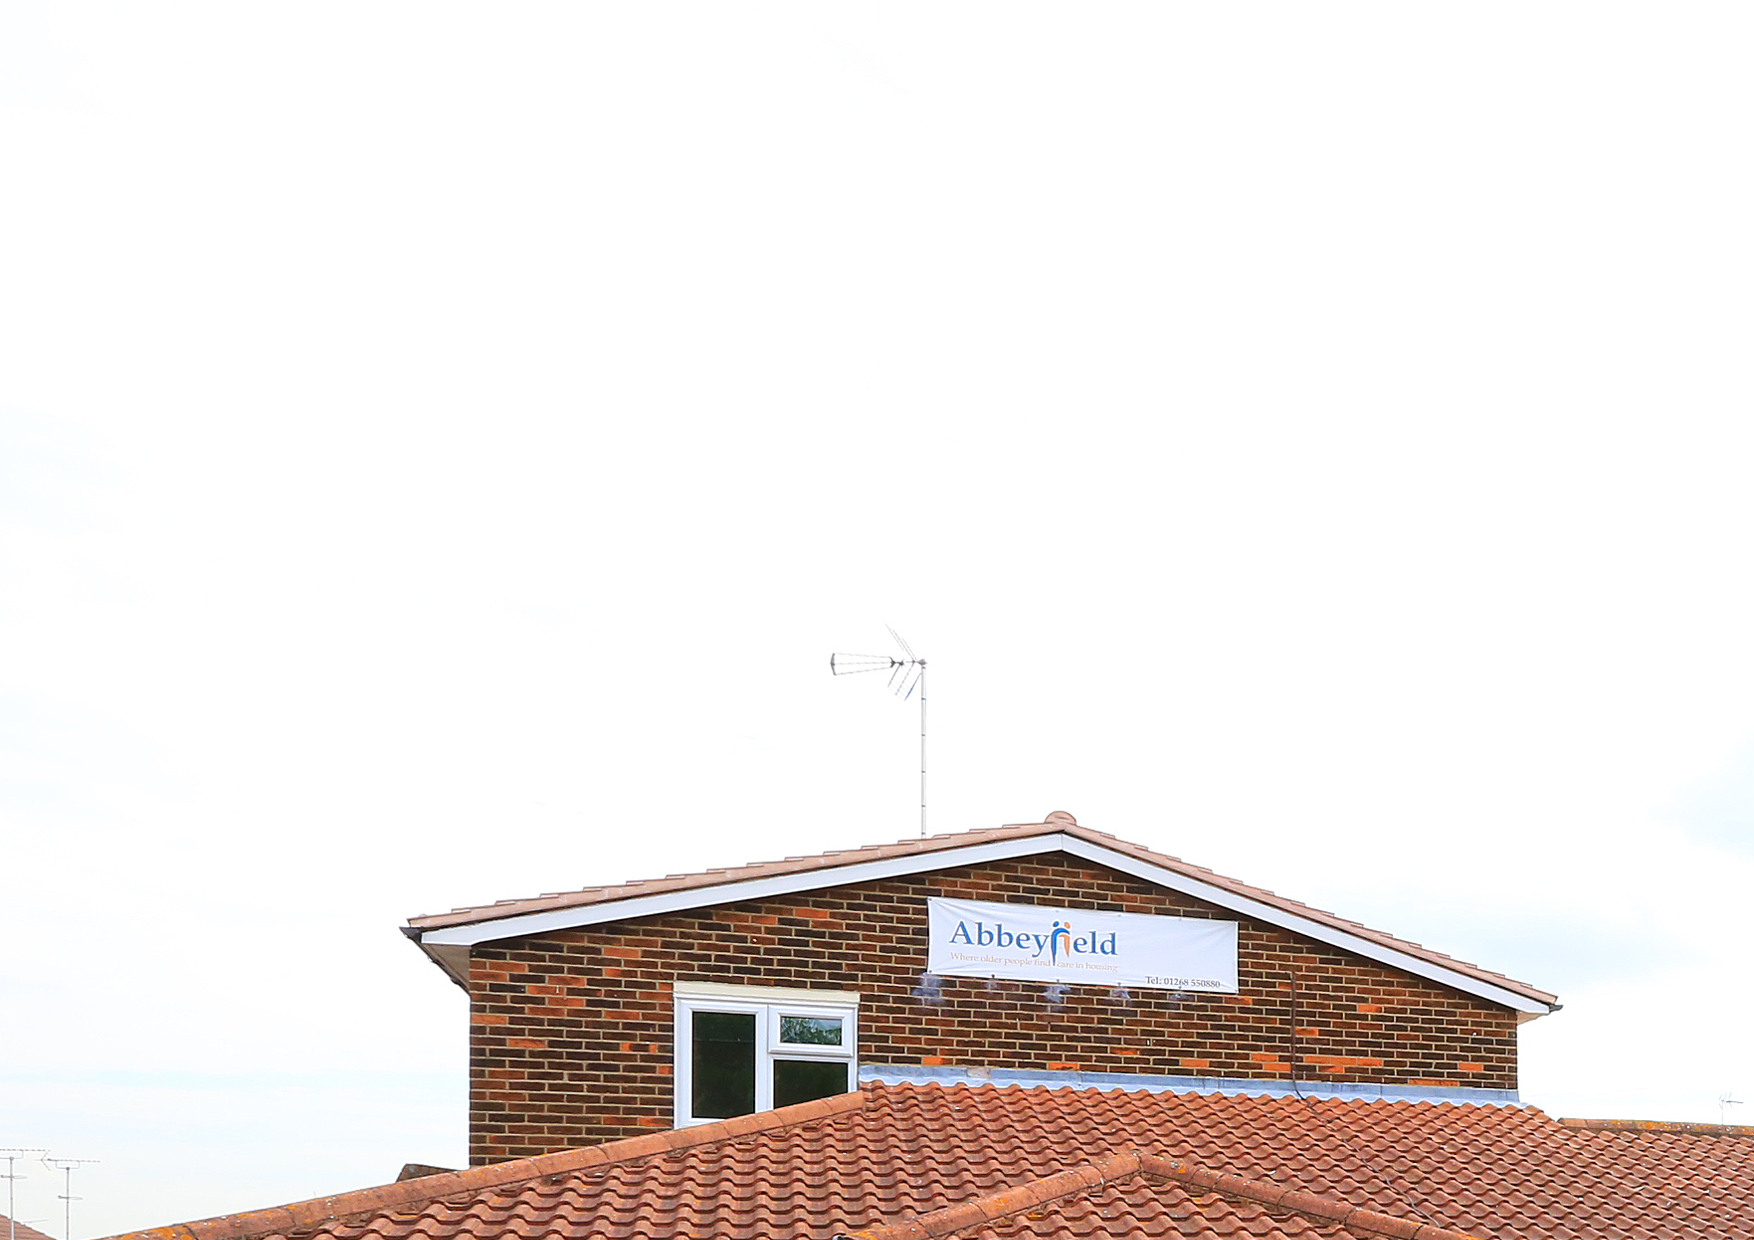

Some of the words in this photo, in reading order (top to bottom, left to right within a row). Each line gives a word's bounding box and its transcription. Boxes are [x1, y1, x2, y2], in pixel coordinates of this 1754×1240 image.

[948, 920, 1118, 966] Abbeyfield
[950, 952, 979, 962] Where
[980, 955, 1003, 963] older
[1004, 957, 1033, 967] people
[1034, 959, 1051, 967] find
[1057, 961, 1074, 969] care
[1085, 962, 1119, 973] housing
[1145, 976, 1162, 985] Tel:
[1163, 977, 1189, 986] 01268
[1190, 979, 1221, 989] 550880
